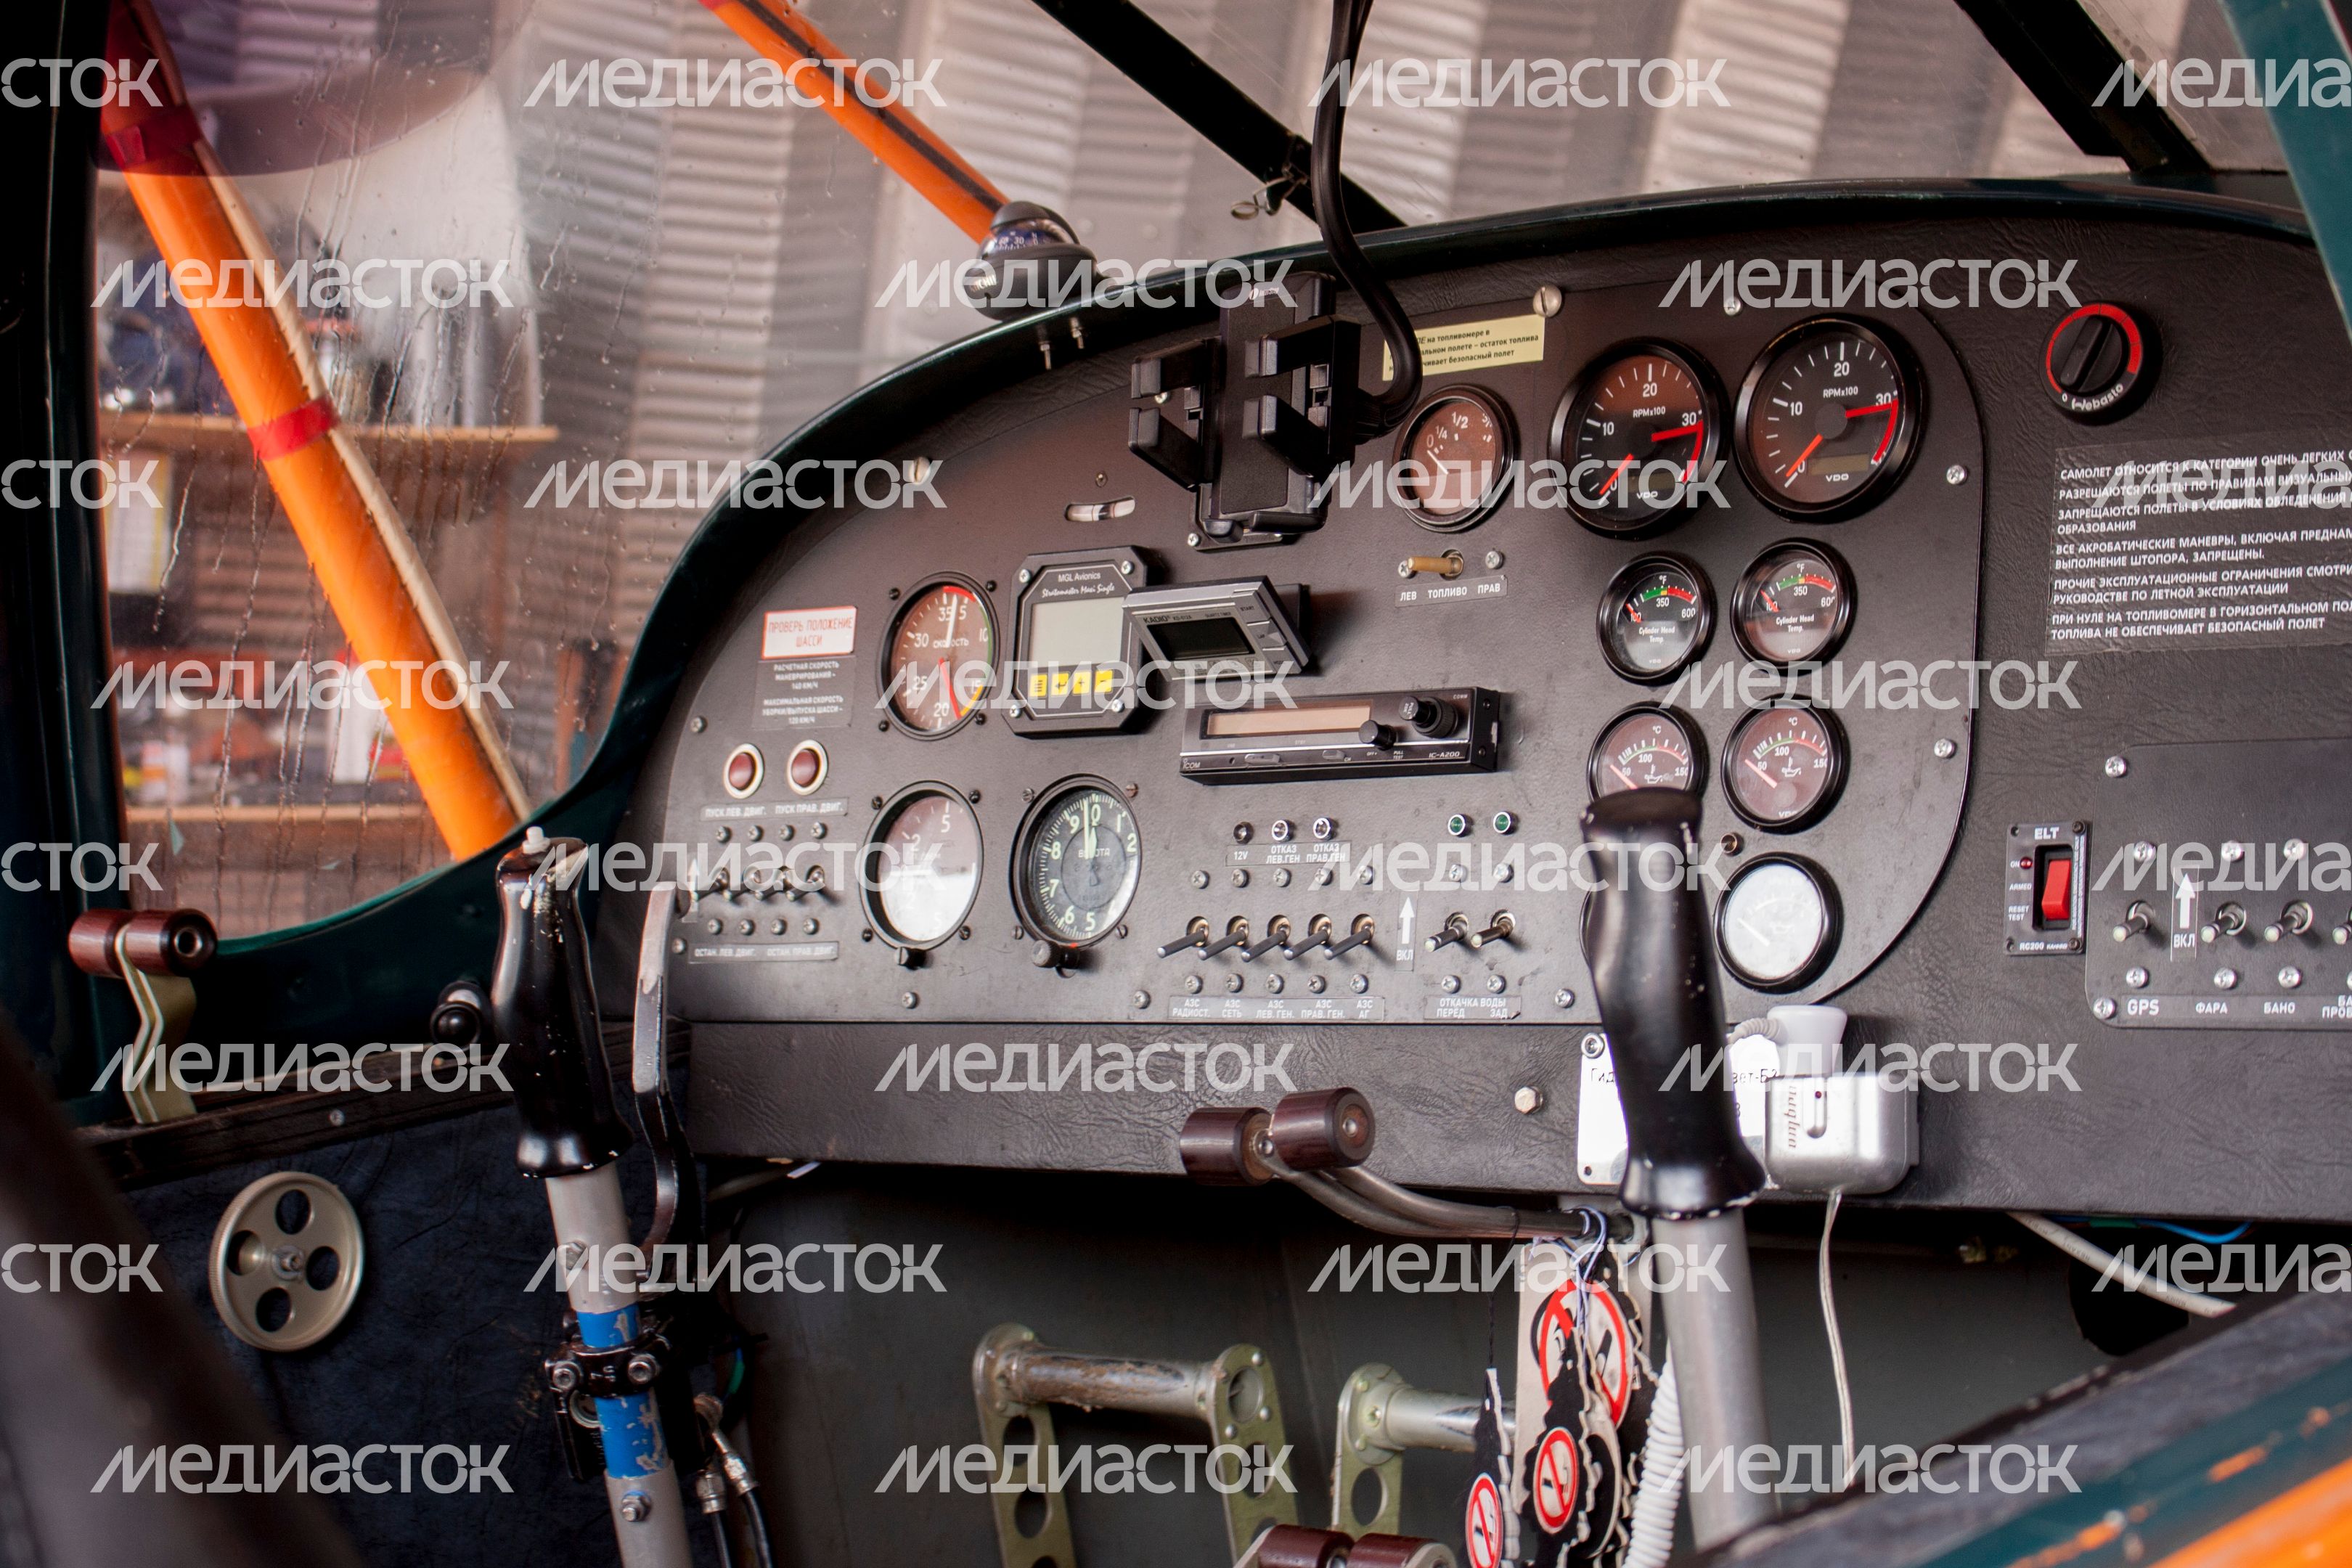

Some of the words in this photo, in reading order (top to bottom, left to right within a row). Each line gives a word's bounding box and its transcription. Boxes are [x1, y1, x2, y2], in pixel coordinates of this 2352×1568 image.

[1437, 330, 1484, 342] топливомере
[1447, 343, 1472, 352] полете
[1480, 339, 1507, 348] остаток
[1509, 335, 1539, 344] топлива
[1449, 351, 1492, 364] безопасный
[1493, 349, 1514, 359] полет
[1834, 362, 1850, 377] 20
[1643, 383, 1657, 397] 20
[1823, 386, 1858, 398] RPMx100
[1876, 393, 1892, 406] 30
[1633, 407, 1666, 418] RPMx100
[1790, 401, 1803, 416] 10
[1452, 412, 1469, 429] 1/2
[1682, 412, 1696, 426] 30
[1435, 425, 1447, 440] 1/4
[1603, 422, 1614, 436] 10
[1426, 434, 1434, 448] 0
[2060, 467, 2111, 480] САМОЛЕТ
[2115, 462, 2179, 476] ОТНОСИТСЯ
[2182, 462, 2189, 471] К
[2193, 457, 2257, 471] КАТЕГОРИИ
[2261, 454, 2298, 466] ОЧЕНЬ
[2301, 450, 2344, 463] ЛЕГКИХ
[1826, 473, 1849, 482] VDO
[2059, 485, 2140, 500] РАЗРЕШАЮТСЯ
[2143, 482, 2187, 495] ПОЛЕТЫ
[2192, 481, 2207, 491] ПО
[2211, 475, 2274, 490] ПРАВИЛАМ
[1637, 491, 1658, 499] VDO
[2058, 506, 2140, 520] ЗАПРЕЩАЮТСЯ
[2144, 502, 2187, 515] ПОЛЕТЫ
[2192, 502, 2198, 512] В
[2202, 497, 2262, 511] УСЛОВИЯХ
[2265, 491, 2346, 507] ОБЛЕДЕНЕНИЯ
[2057, 520, 2136, 535] ОБРАЗОВАНИЯ
[2056, 544, 2075, 555] ВСЕ
[2078, 537, 2176, 554] АКРОБАТИЧЕСКИЕ
[2179, 534, 2237, 548] МАНЕВРЫ,
[2241, 531, 2297, 544] ВКЛЮЧАЯ
[2055, 556, 2127, 570] ВЫПОЛНЕНИЕ
[2131, 552, 2189, 566] ШТОПОРА,
[2192, 548, 2265, 563] ЗАПРЕЩЕНЫ.
[1058, 573, 1074, 583] MGL
[1074, 571, 1101, 581] Avionics
[2054, 578, 2096, 589] ПРОЧИЕ
[2099, 571, 2218, 589] ЭКСПЛУАТАЦИОННЫЕ
[2221, 566, 2303, 581] ОГРАНИЧЕНИЯ
[1428, 587, 1467, 599] ТОПЛИВО
[1478, 583, 1500, 594] ПРАВ
[1793, 586, 1808, 596] 350
[2053, 591, 2128, 605] РУКОВОДСТВЕ
[2131, 590, 2147, 601] ПО
[2150, 586, 2194, 600] ЛЕТНОЙ
[2197, 582, 2289, 597] ЭКСПЛУАТАЦИИ
[1400, 591, 1417, 601] ЛЕВ
[1656, 597, 1670, 608] 350
[959, 605, 967, 620] 5
[1681, 608, 1696, 618] 600
[2052, 614, 2073, 625] ПРИ
[2077, 612, 2104, 624] НУЛЕ
[2107, 612, 2123, 623] НА
[2126, 607, 2206, 621] ТОПЛИВОМЕРЕ
[2210, 607, 2216, 618] В
[2221, 601, 2329, 617] ГОРИЗОНТАЛЬНОМ
[769, 621, 804, 633] ПРОВЕРЬ
[807, 617, 853, 631] ПОЛОЖЕНИЕ
[1776, 616, 1798, 626] Cylinder
[1638, 626, 1659, 636] Cylinder
[2051, 627, 2102, 640] ТОПЛИВА
[2105, 626, 2118, 638] НЕ
[2121, 623, 2205, 638] ОБЕСПЕЧИВАЕТ
[2208, 618, 2284, 633] БЕЗОПАСНЫЙ
[2288, 618, 2325, 629] ПОЛЕТ
[796, 636, 822, 648] ШАССИ
[914, 633, 929, 648] 30
[913, 676, 928, 690] 25
[813, 695, 844, 704] СКОРОСТЬ
[934, 702, 950, 717] 20
[1775, 746, 1789, 756] 100
[1638, 754, 1652, 763] 100
[1757, 761, 1767, 771] 50
[706, 808, 724, 818] ПУСК
[775, 804, 795, 814] ПУСК
[941, 814, 951, 833] 5
[1069, 815, 1080, 833] 9
[2034, 826, 2059, 840] ELT
[1127, 833, 1137, 852] 2
[1313, 843, 1339, 852] ОТКАЗ
[1051, 841, 1061, 859] 8
[1271, 844, 1297, 854] ОТКАЗ
[1234, 851, 1248, 860] 12V
[1266, 854, 1300, 864] ЛЕВ.ГЕН
[1307, 852, 1345, 862] ПРАВ.ГЕН
[1050, 879, 1059, 897] 7
[1064, 905, 1074, 924] 6
[1085, 912, 1095, 931] 5
[2173, 934, 2196, 948] ВКЛ
[1397, 950, 1413, 961] ВКЛ
[1184, 998, 1200, 1007] АЗС
[1225, 999, 1241, 1008] АЗС
[1267, 1000, 1284, 1008] АЗС
[1315, 1000, 1332, 1008] АЗС
[1356, 1000, 1373, 1008] АЗС
[1440, 997, 1478, 1008] ОТКАЧКА
[1480, 997, 1506, 1008] ВОДЫ
[2127, 998, 2160, 1015] GPS
[2195, 1001, 2228, 1014] ФАРА
[2263, 1001, 2296, 1014] БАНО
[1172, 1008, 1211, 1017] РАДИОСТ.
[1222, 1009, 1242, 1018] СЕТЬ
[1256, 1010, 1275, 1018] ЛЕВ.
[1277, 1010, 1294, 1018] ГЕН.
[1301, 1010, 1325, 1018] ПРАВ.
[1328, 1009, 1345, 1018] ГЕН.
[1359, 1010, 1369, 1018] АГ
[1437, 1008, 1465, 1018] ПЕРЕД
[1490, 1008, 1508, 1018] ЗАД
